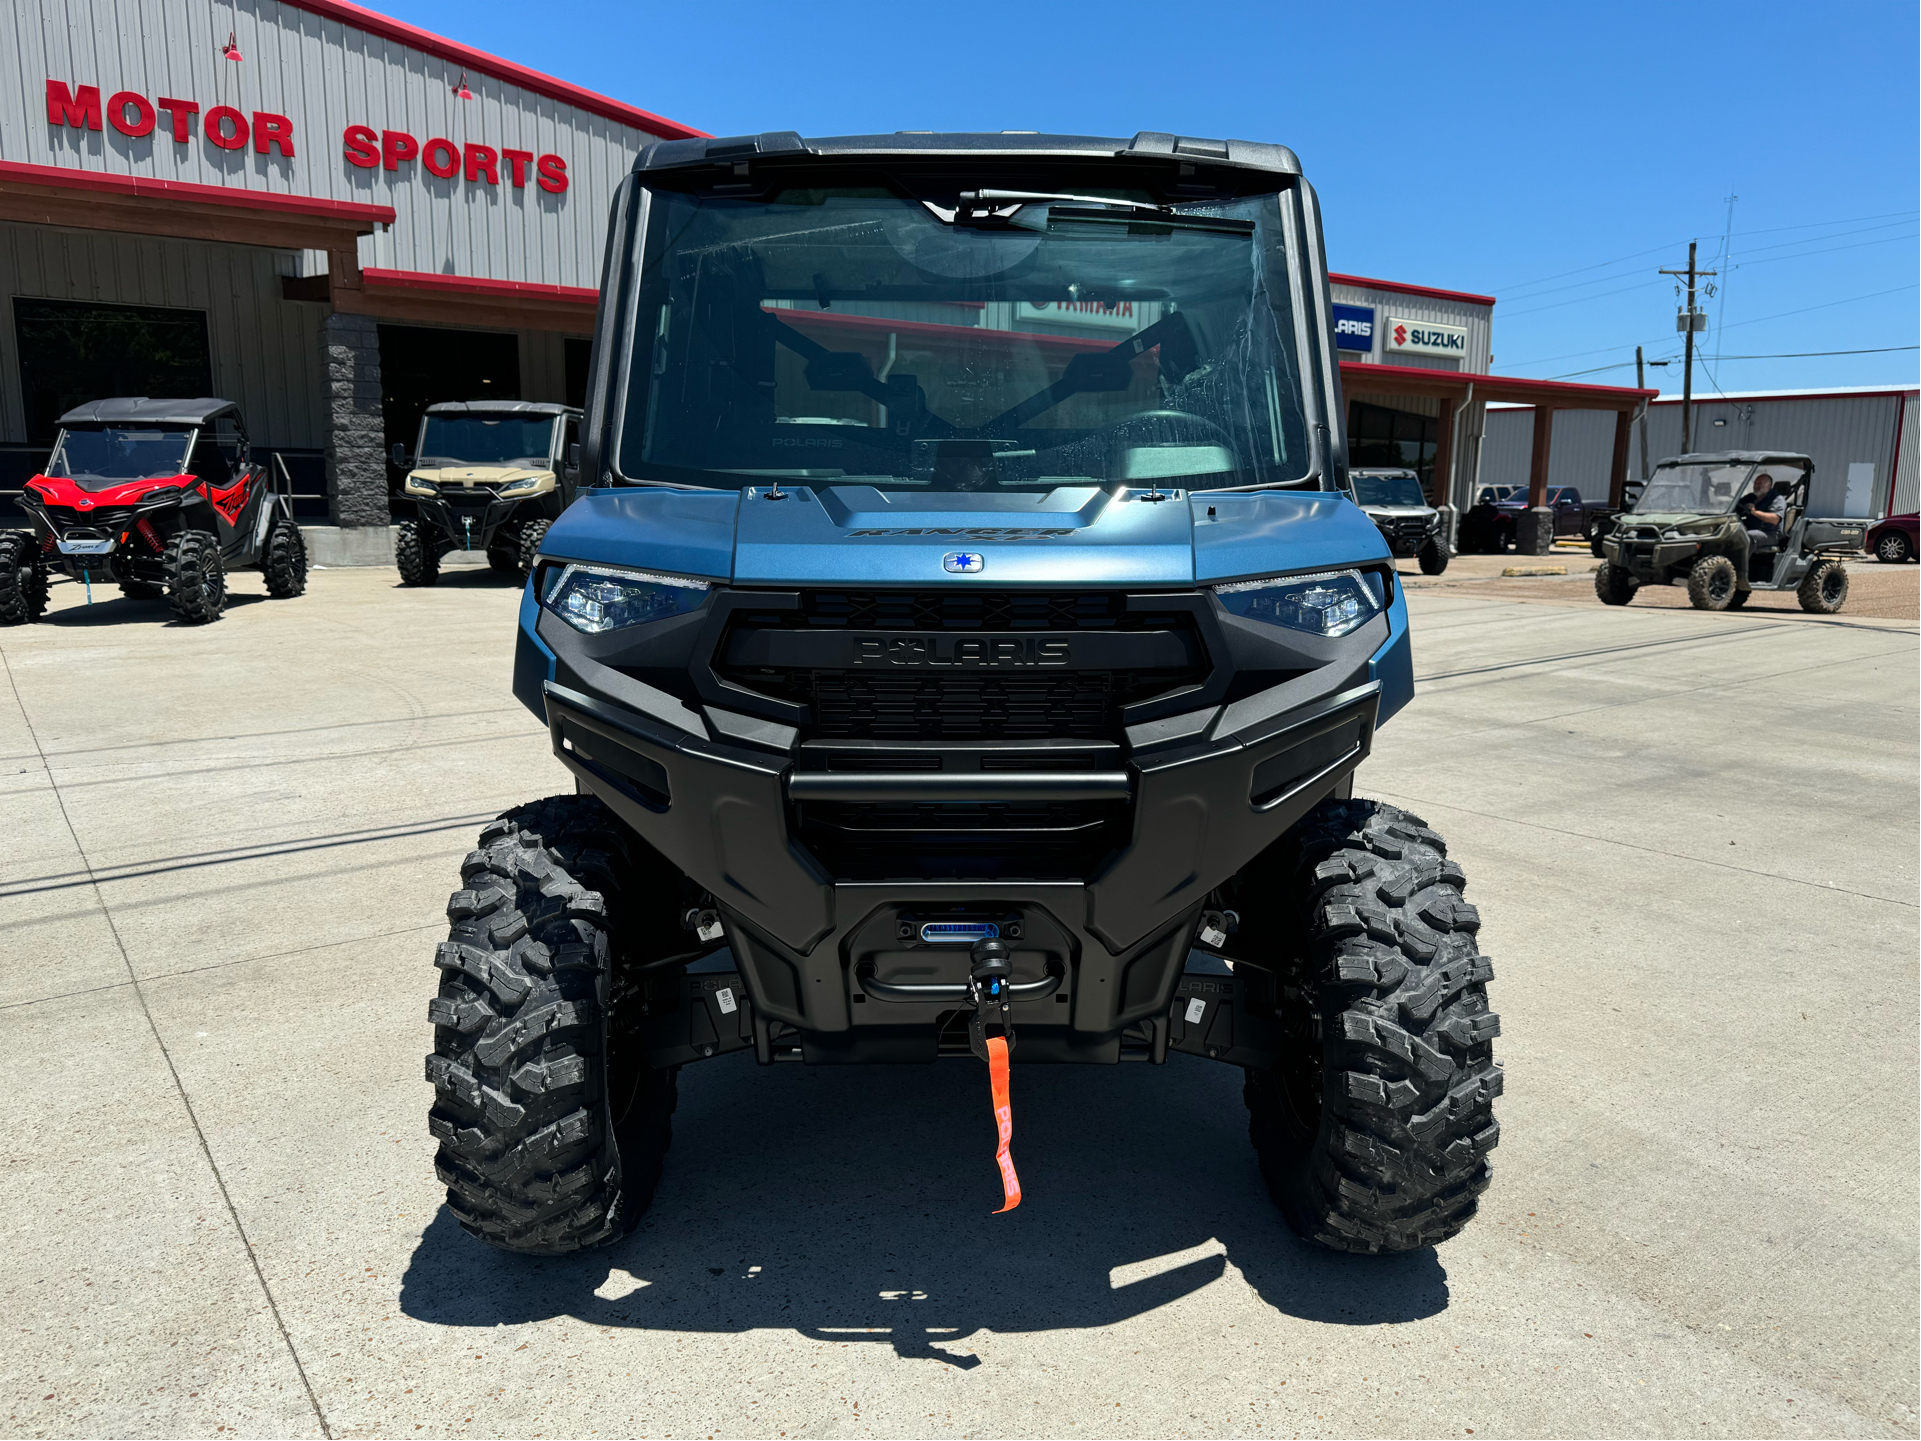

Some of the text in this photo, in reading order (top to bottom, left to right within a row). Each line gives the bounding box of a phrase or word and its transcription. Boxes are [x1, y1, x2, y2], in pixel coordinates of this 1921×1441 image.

[46, 79, 569, 193] MOTOR SPORTS
[1335, 319, 1372, 336] ARIS
[1411, 329, 1465, 349] SUZUKI
[772, 438, 843, 448] POLARIS
[853, 637, 1071, 665] POLARIS
